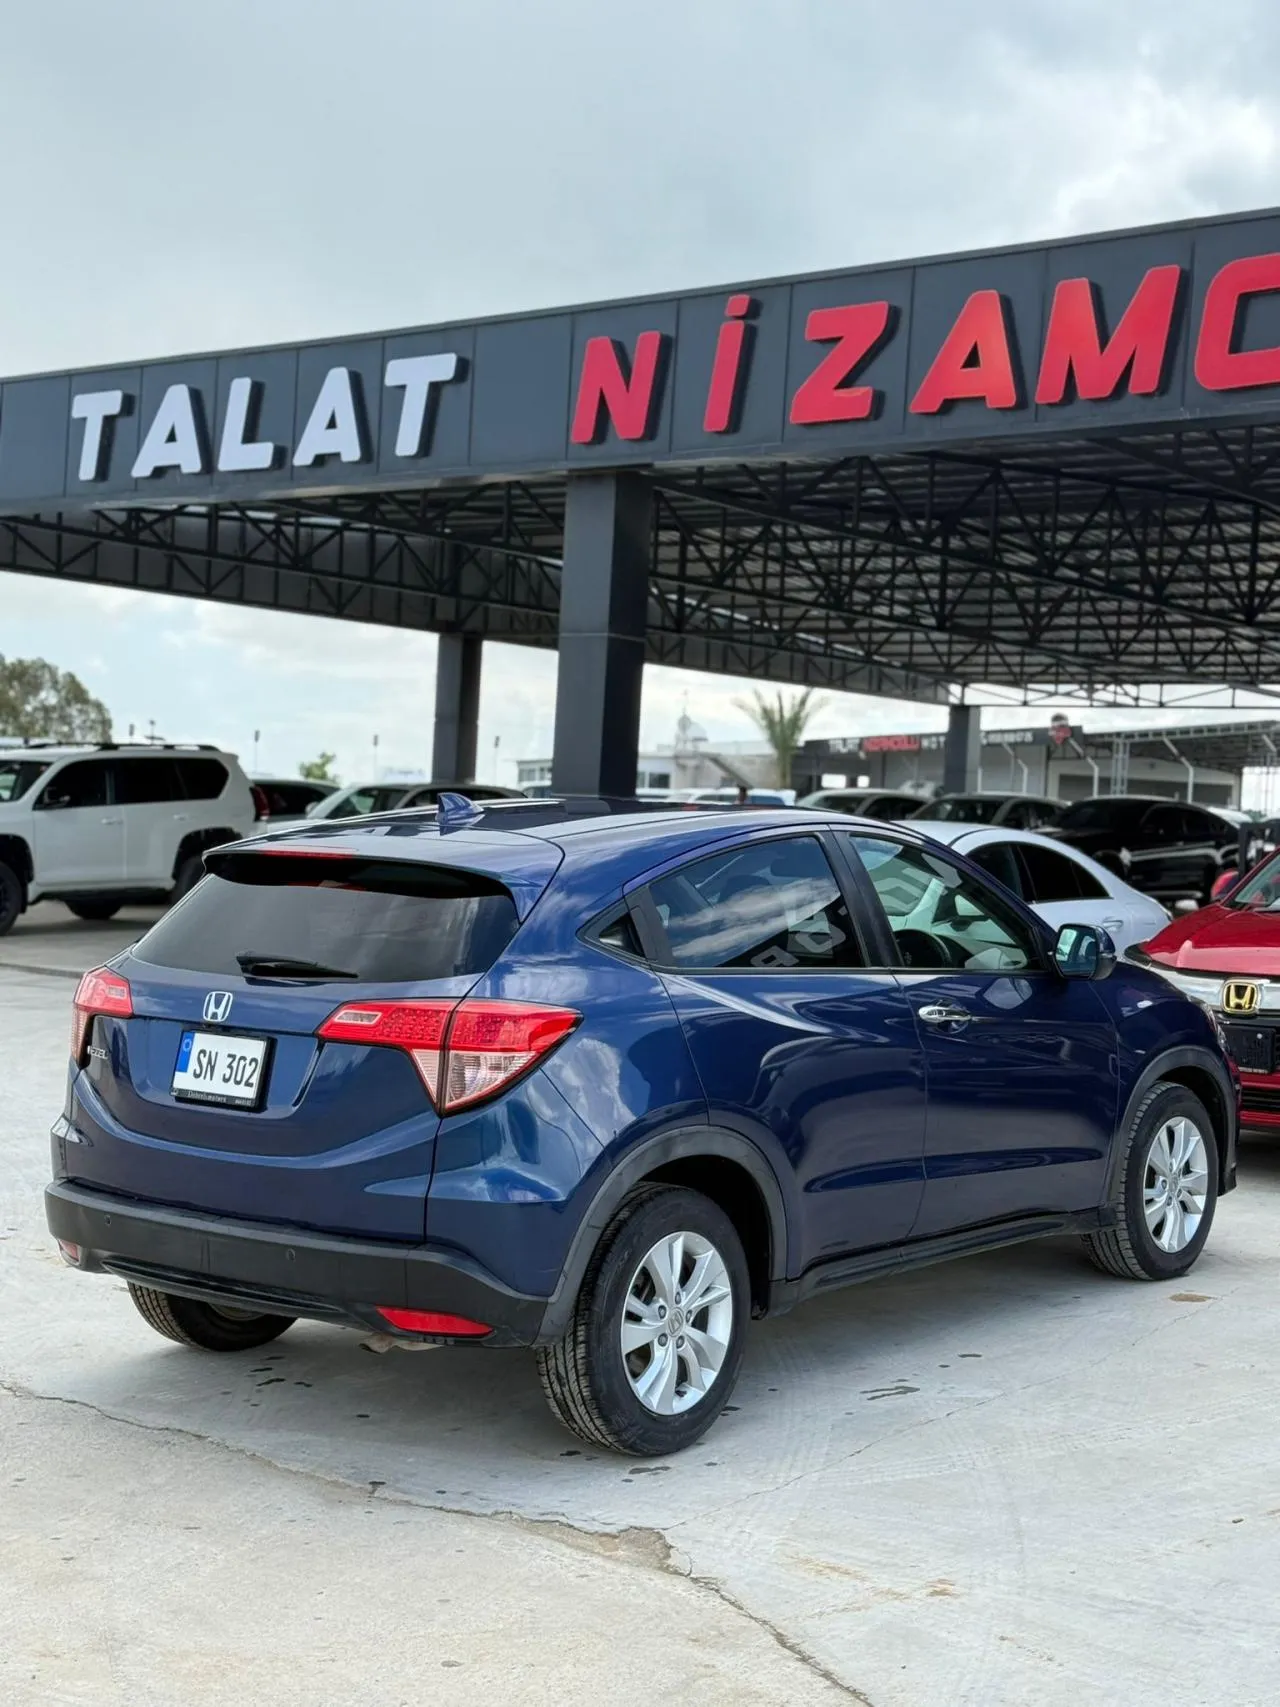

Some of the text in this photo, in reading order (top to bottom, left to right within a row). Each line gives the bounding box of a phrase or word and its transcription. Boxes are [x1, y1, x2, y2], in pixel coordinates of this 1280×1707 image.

[71, 352, 459, 482] TALAT
[192, 1048, 259, 1088] SN 302
